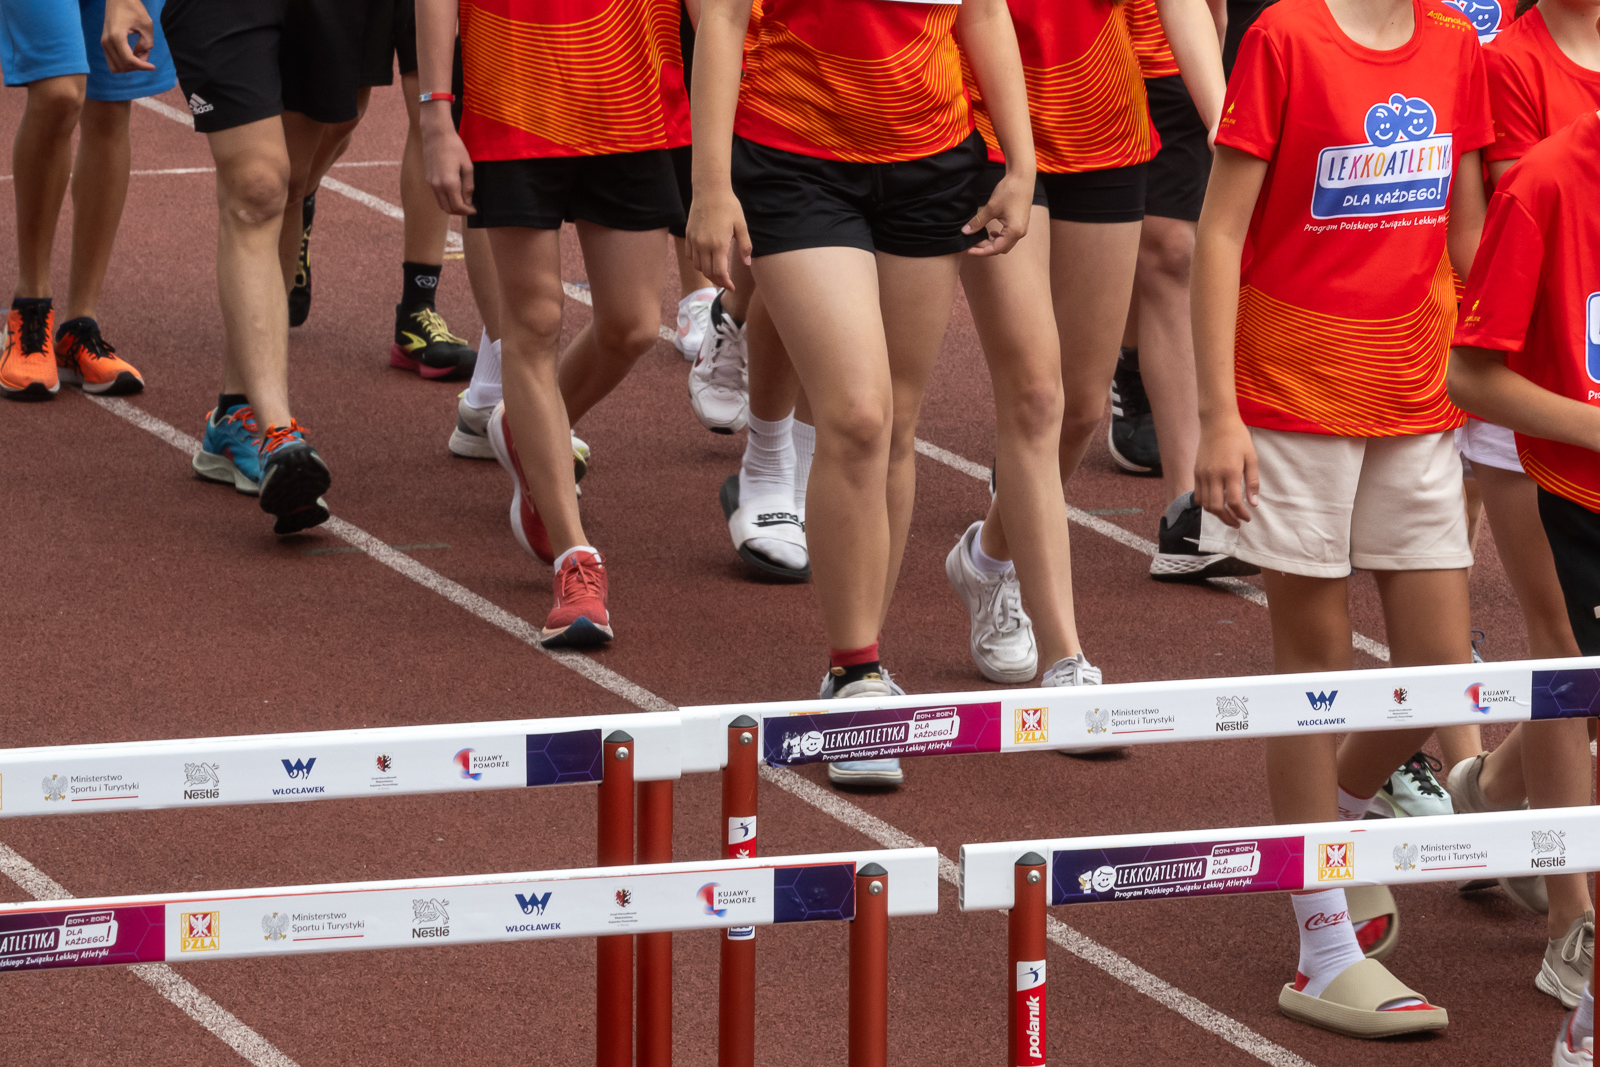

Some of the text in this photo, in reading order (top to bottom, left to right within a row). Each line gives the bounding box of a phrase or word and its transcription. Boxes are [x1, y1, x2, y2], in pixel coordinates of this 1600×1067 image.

[1343, 177, 1443, 207] DLA KAŻDEGO!
[1303, 222, 1337, 234] Program
[1340, 220, 1378, 232] Polskiego
[1380, 218, 1412, 230] Związku
[1414, 216, 1438, 228] Lekkiej
[1111, 707, 1159, 716] Ministerstwo
[914, 722, 930, 731] DLA
[1111, 718, 1136, 727] Sportu
[1142, 715, 1175, 726] Turystyki
[1215, 721, 1249, 732] Nestlé
[1297, 718, 1346, 726] WŁOCŁAWEK
[913, 717, 954, 739] KAŻDEGO!
[825, 725, 906, 749] LEKKOATLETYKA
[1016, 732, 1047, 743] PZLA
[850, 749, 878, 759] Polskiego
[879, 747, 904, 757] Związku
[905, 744, 926, 754] Lekkiej
[927, 741, 953, 751] Atletyki
[473, 761, 510, 769] POMORZE
[71, 774, 123, 783] Ministerstwo
[70, 784, 97, 794] Sportu
[104, 782, 140, 793] Turystyki
[272, 786, 325, 795] WŁOCŁAWEK
[184, 789, 220, 800] Nestlé
[1420, 842, 1472, 852] Ministerstwo
[1420, 853, 1447, 863] Sportu
[1453, 850, 1488, 862] Turystyki
[1530, 856, 1566, 868] Nestlé
[1211, 853, 1255, 876] KAŻDEGO!
[1212, 858, 1229, 867] DLA
[1117, 860, 1203, 885] LEKKOATLETYKA
[1320, 868, 1352, 879] PZLA
[718, 890, 749, 898] KUJAWY
[1114, 878, 1253, 899] Program Polskiego Związku Lekkiej Atletyki
[718, 897, 757, 905] POMORZE
[292, 911, 347, 921] Ministerstwo
[291, 922, 319, 933] Sportu
[327, 920, 365, 932] Turystyki
[411, 925, 450, 939] Nestlé
[505, 923, 562, 933] WŁOCŁAWEK
[64, 925, 112, 947] KAŻDEGO!
[66, 928, 83, 937] DLA
[0, 931, 56, 953] ATLETYKA
[183, 939, 217, 950] PZLA
[0, 948, 109, 968] lskiego Związku Lekkiej Atletyki
[1026, 995, 1042, 1058] polanik
